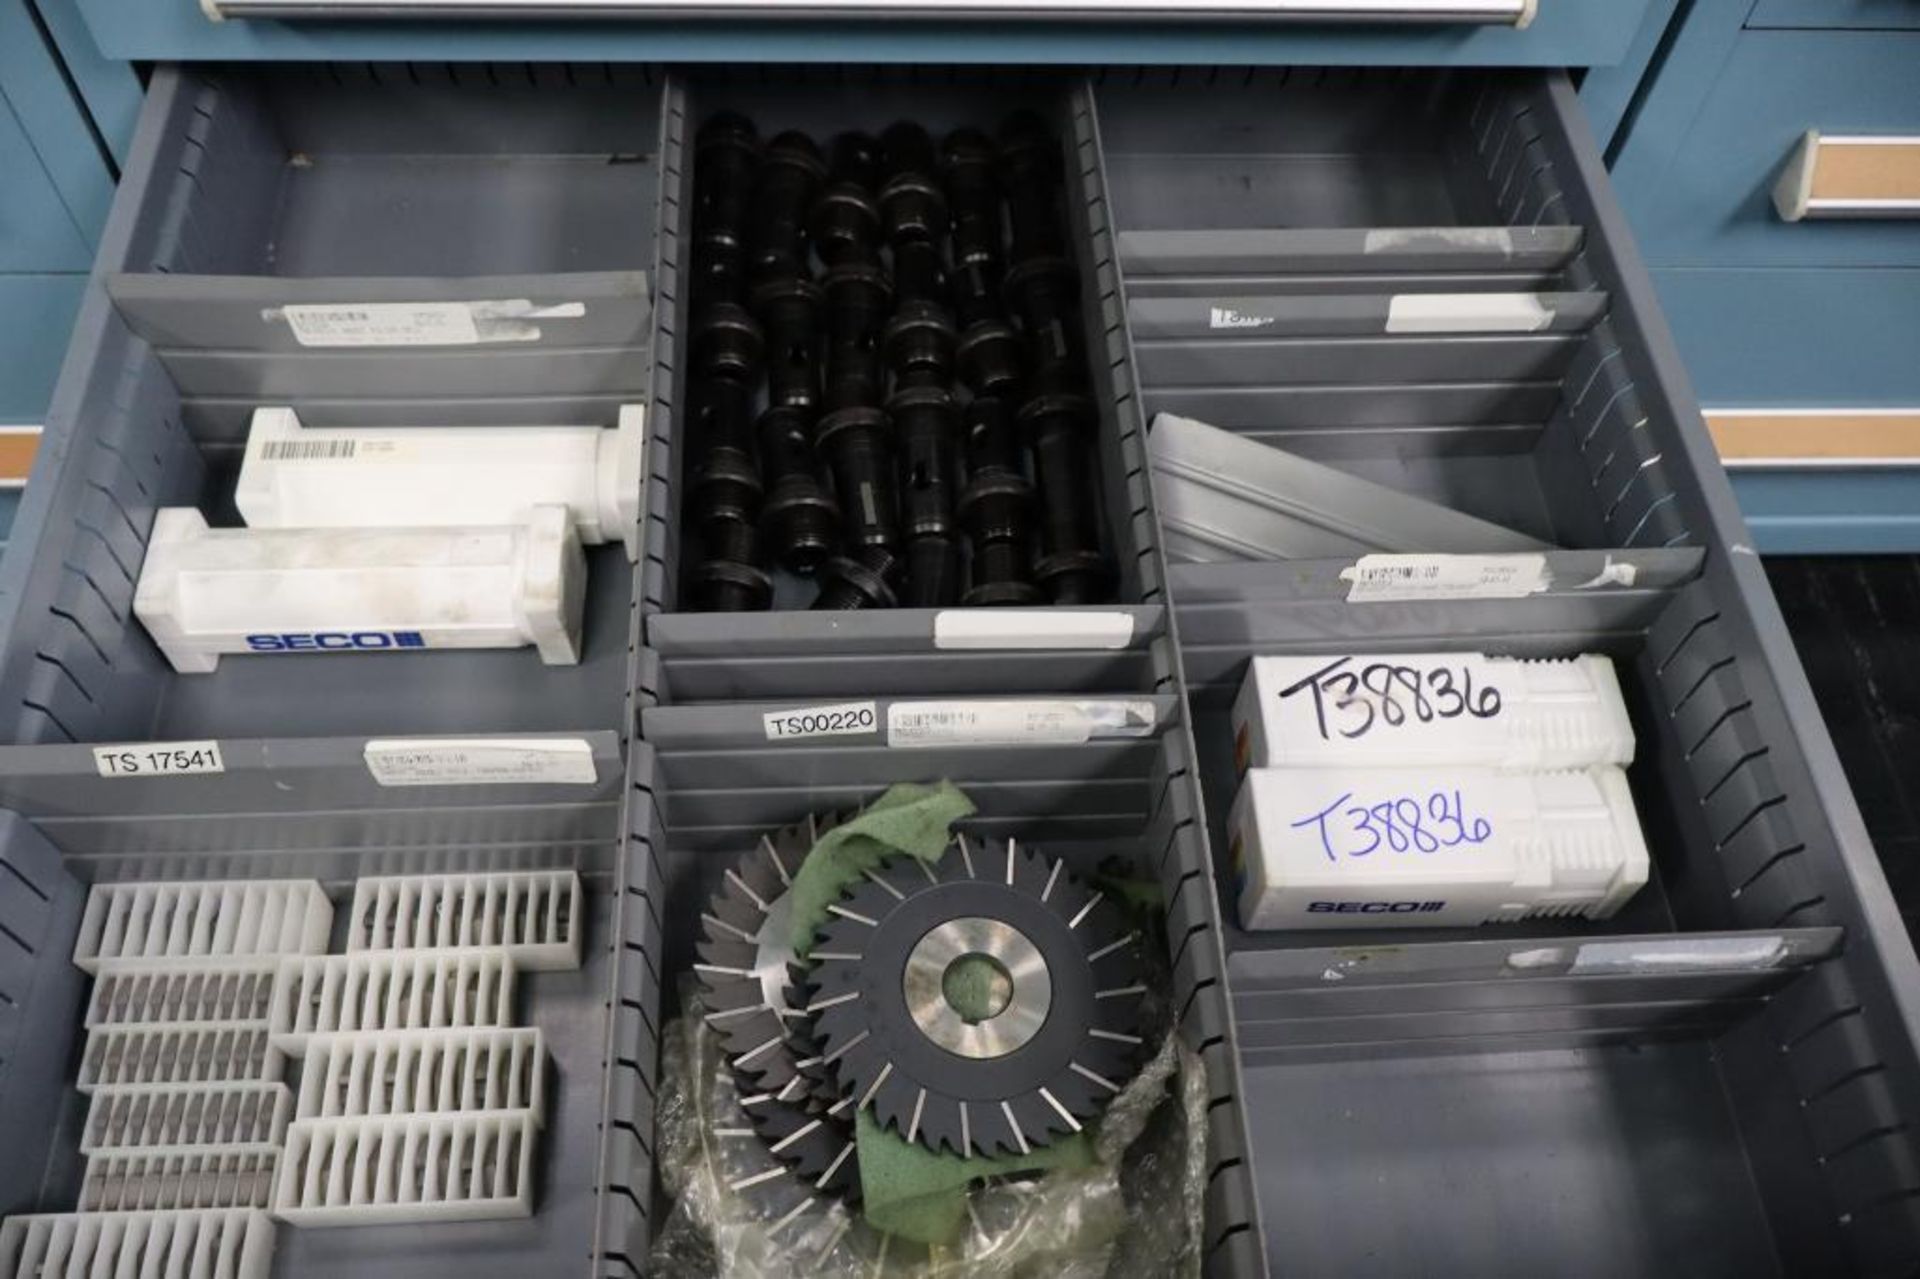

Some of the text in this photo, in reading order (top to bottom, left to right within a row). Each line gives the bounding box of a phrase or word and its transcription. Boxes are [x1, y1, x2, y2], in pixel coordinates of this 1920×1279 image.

[247, 632, 391, 650] SECO
[1279, 656, 1502, 740] T38836
[770, 708, 874, 736] TS00220
[104, 750, 217, 772] TS 17541
[1291, 790, 1492, 861] T38836
[1307, 901, 1419, 914] SECO
